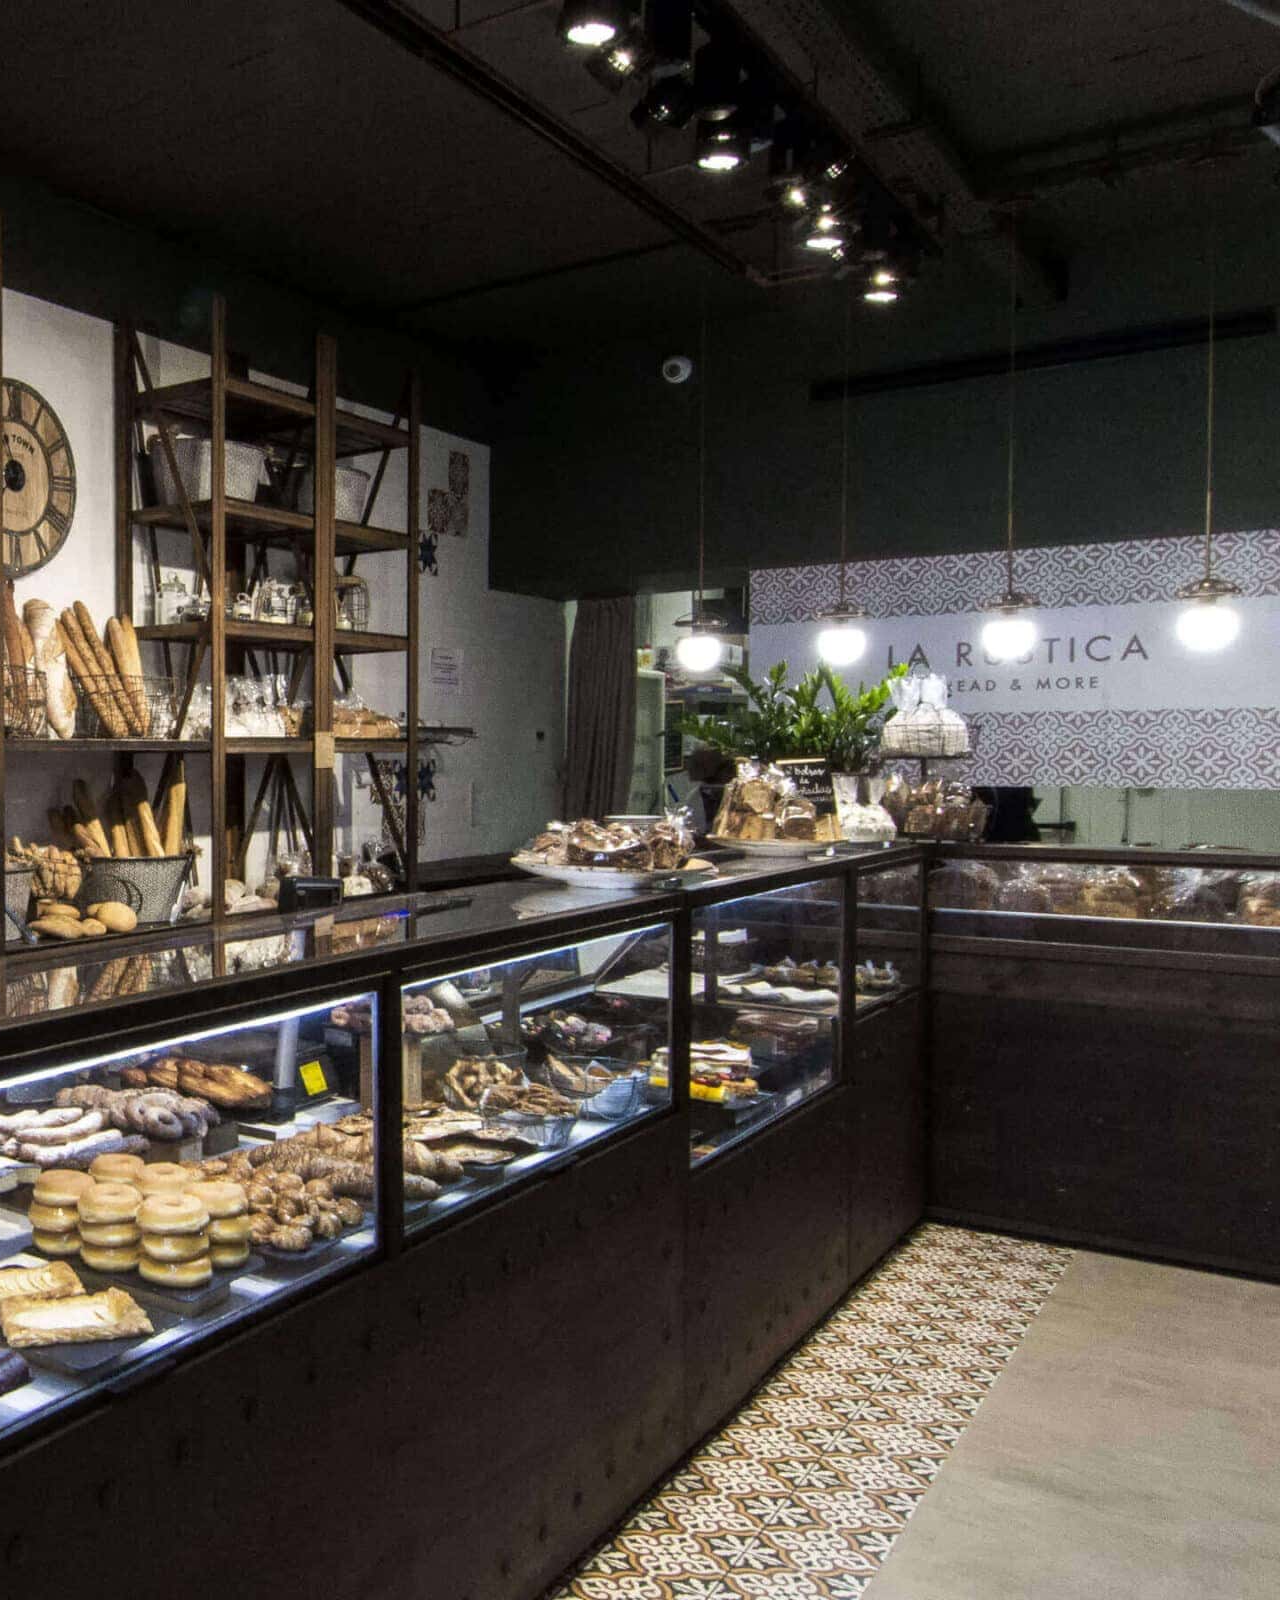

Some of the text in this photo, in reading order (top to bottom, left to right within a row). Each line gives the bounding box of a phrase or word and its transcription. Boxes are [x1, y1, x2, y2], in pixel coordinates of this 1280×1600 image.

[956, 633, 1149, 667] RTICA
[1009, 678, 1022, 691] &
[1035, 676, 1099, 690] MORE
